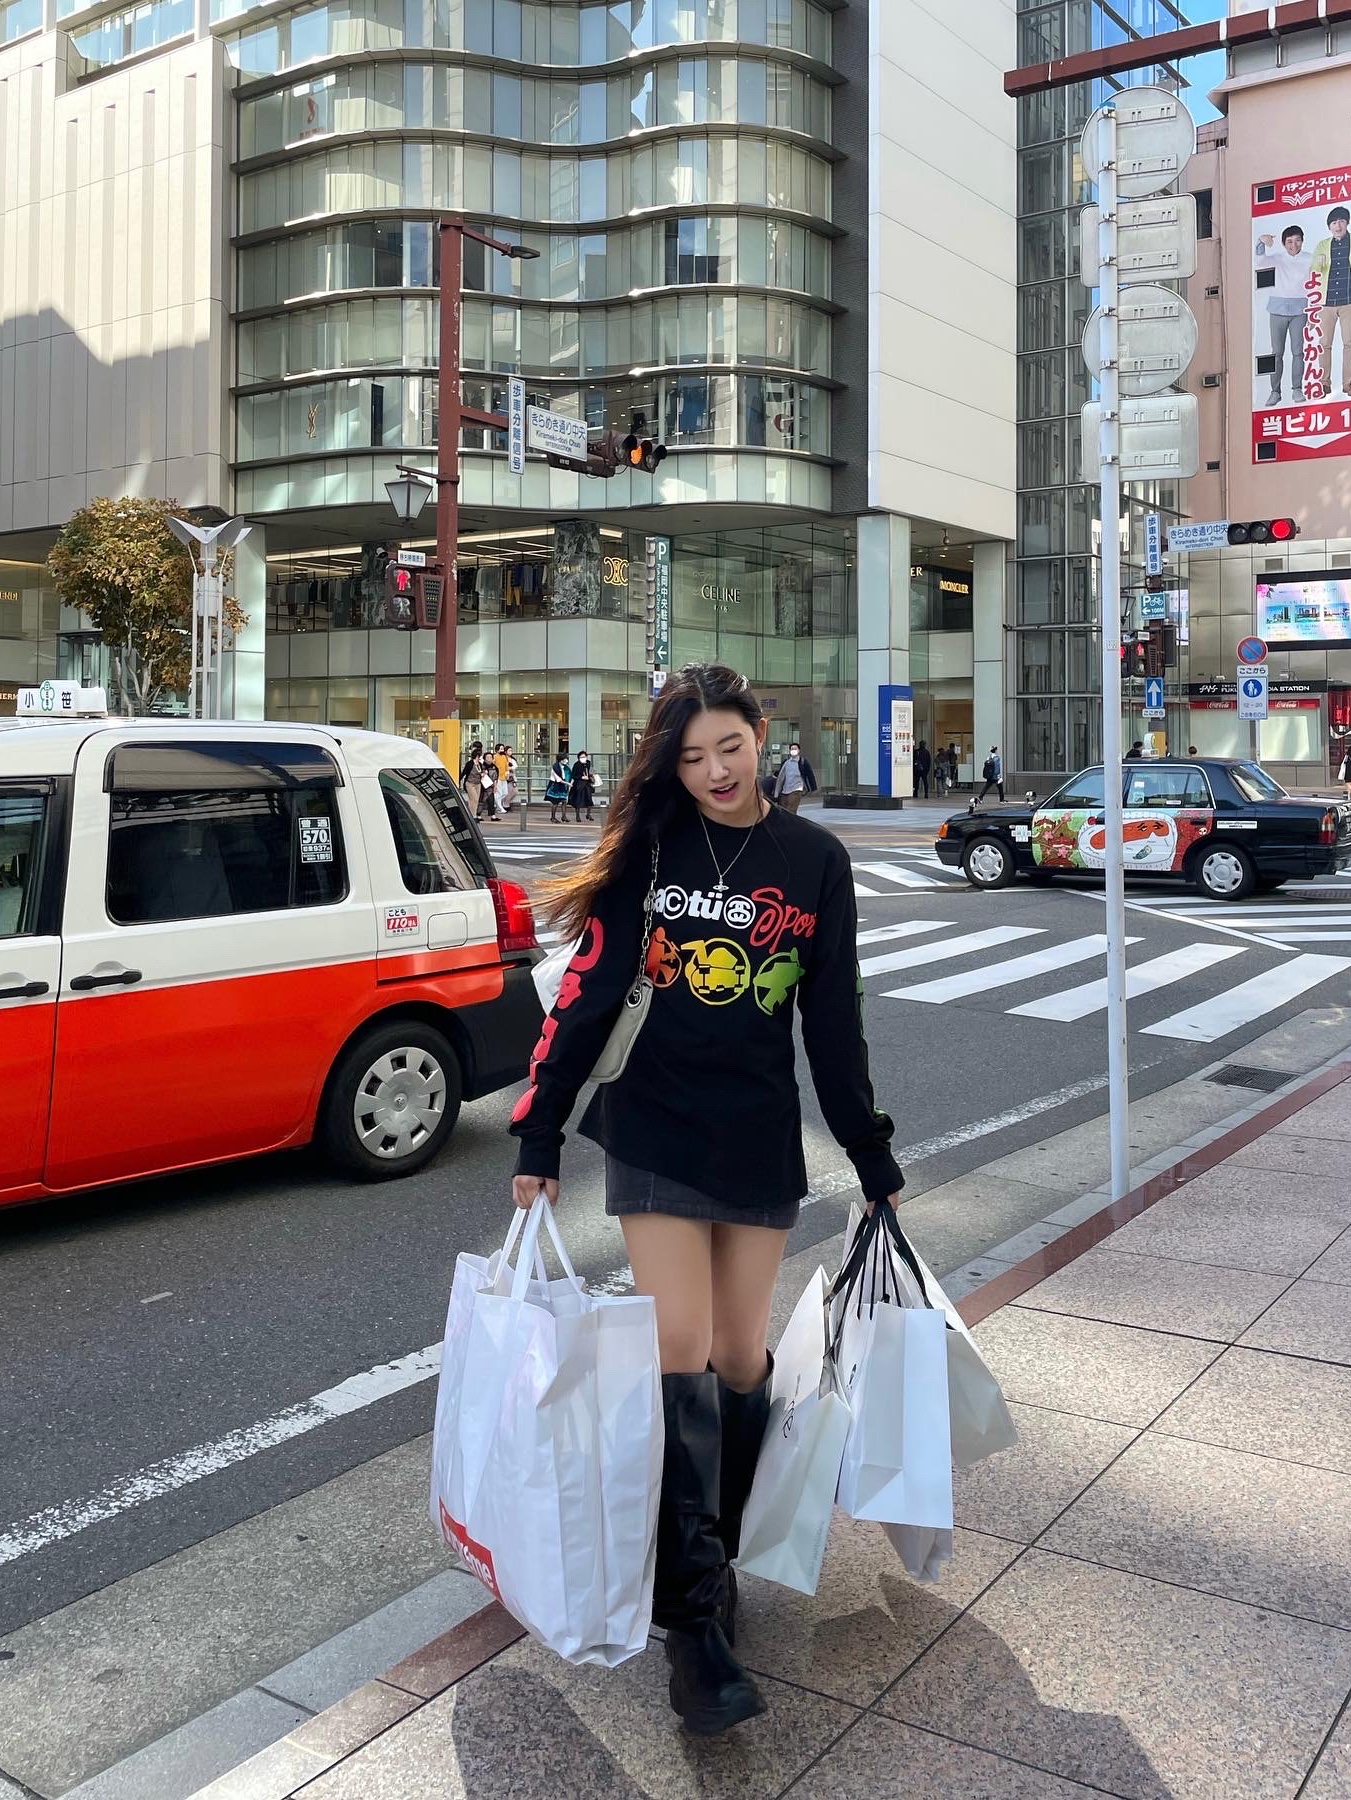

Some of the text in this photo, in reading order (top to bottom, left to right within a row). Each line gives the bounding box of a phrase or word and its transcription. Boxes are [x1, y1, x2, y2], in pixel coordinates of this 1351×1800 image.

[1281, 172, 1350, 193] パチンコ・スロット
[1303, 271, 1323, 400] よっていかんね
[512, 384, 522, 470] 歩車分離信号
[531, 411, 587, 441] きらめき通り中央
[1261, 410, 1331, 437] 当ビル
[1170, 523, 1229, 540] きらめき通り中央
[658, 541, 668, 561] P
[1148, 517, 1158, 572] 歩車分離信号
[701, 583, 741, 604] CELINE
[939, 580, 969, 594] MONCLER
[1143, 595, 1151, 606] P
